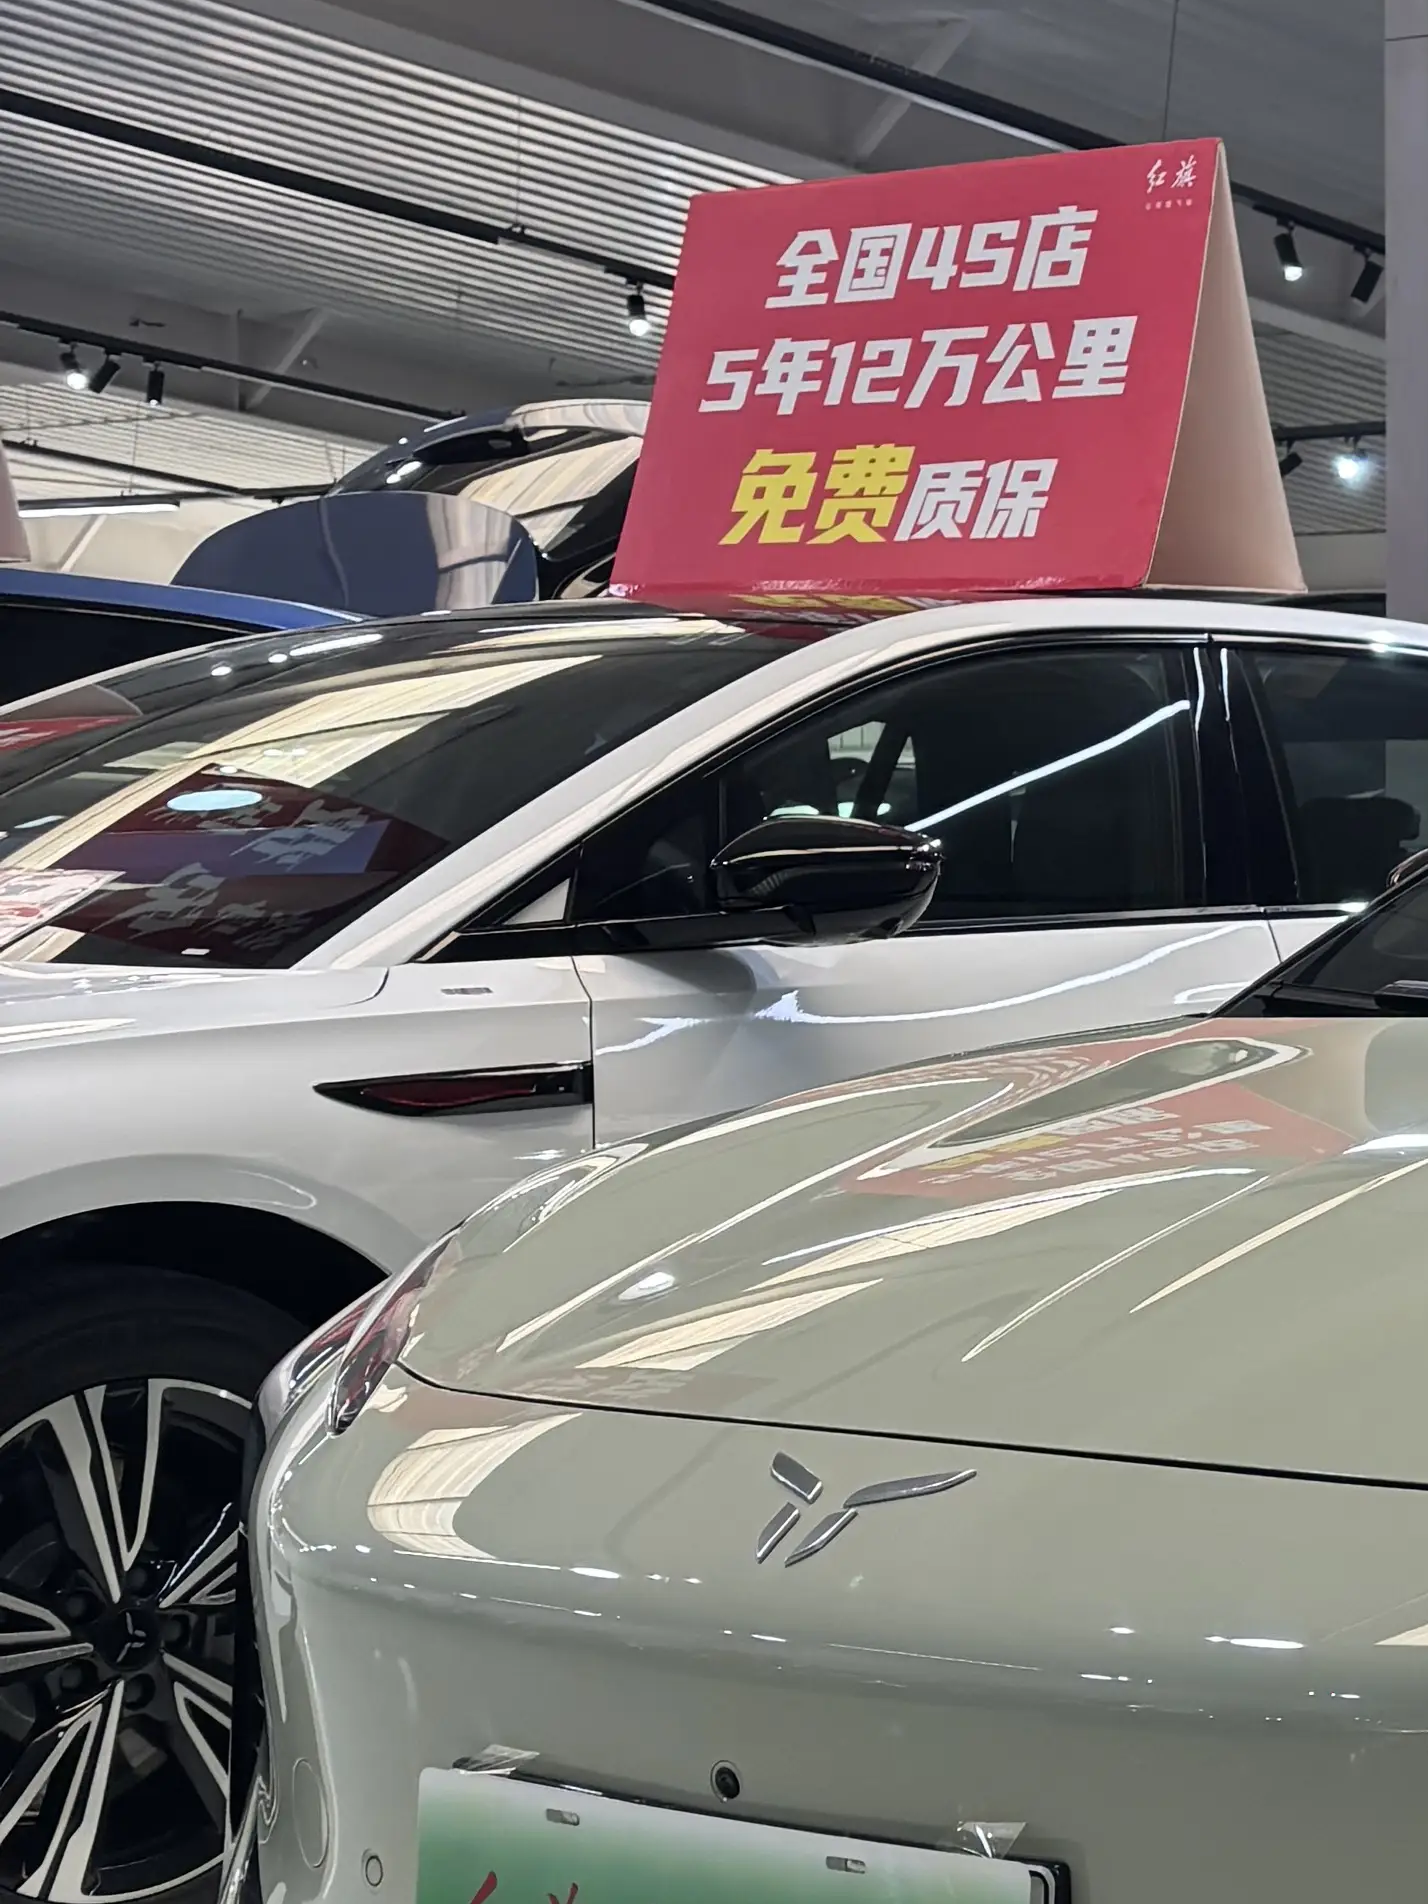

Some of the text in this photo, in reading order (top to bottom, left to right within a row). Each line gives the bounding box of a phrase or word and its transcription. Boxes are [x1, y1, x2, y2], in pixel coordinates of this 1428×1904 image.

[1146, 154, 1197, 194] 红旗
[765, 205, 1098, 309] 全国4S店
[699, 315, 1138, 415] 5年12万公里
[719, 443, 1058, 545] 免费质保
